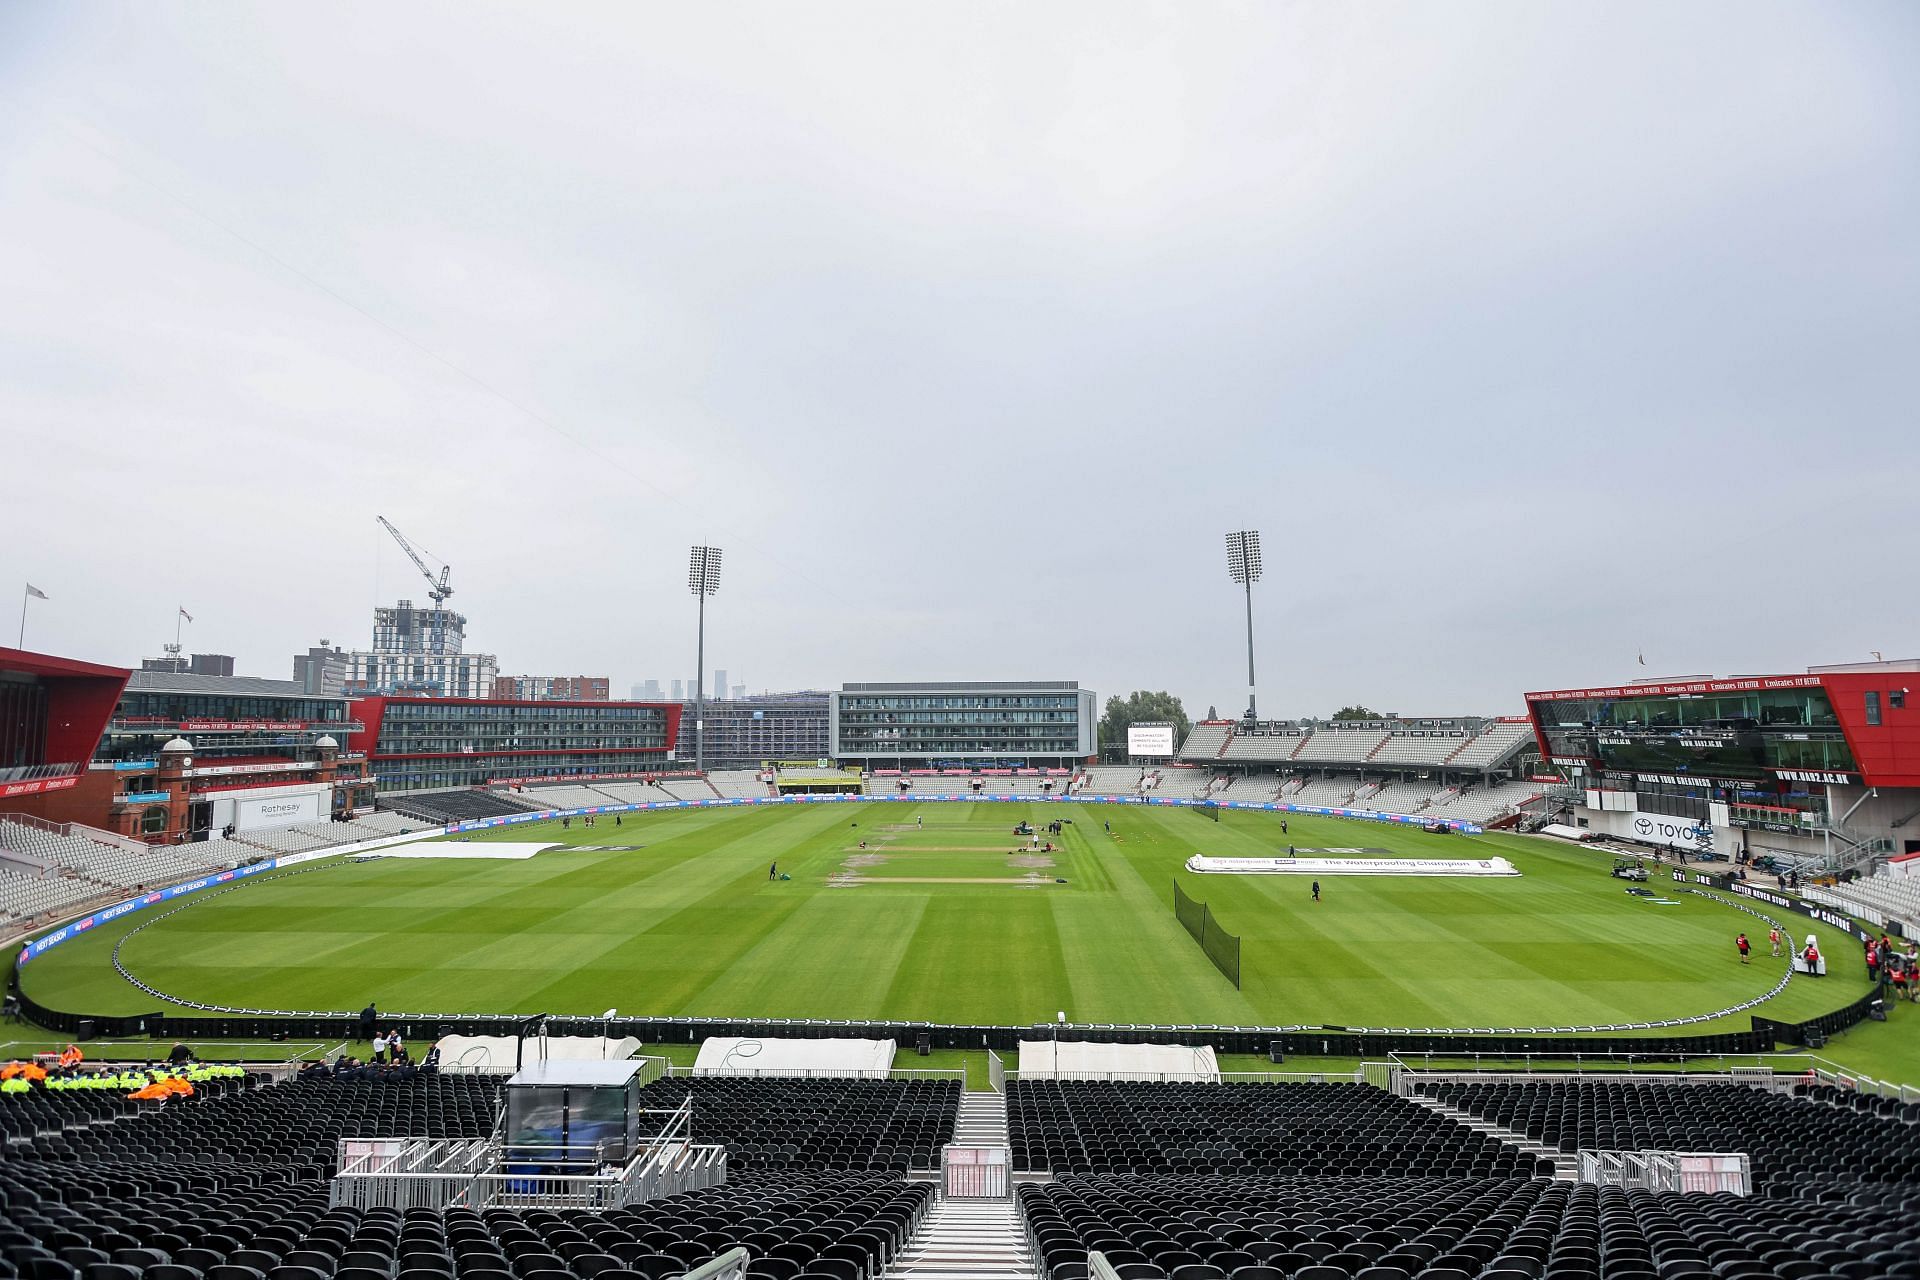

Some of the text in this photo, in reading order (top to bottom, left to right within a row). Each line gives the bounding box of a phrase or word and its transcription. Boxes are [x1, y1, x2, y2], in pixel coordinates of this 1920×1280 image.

[1660, 776, 1676, 785] YOUR
[1676, 777, 1711, 788] GREATNESS
[1718, 780, 1741, 789] UA92
[1776, 770, 1849, 784] WWW.UA92.AC.UK
[262, 804, 300, 813] Rothesay
[1657, 824, 1693, 840] TOYO
[255, 863, 271, 871] SEASON
[172, 880, 207, 895] NEXT SEASON
[1731, 883, 1790, 907] BETTER NEVER STOPS
[103, 902, 134, 920] NEXT SEASON
[1822, 911, 1851, 932] CASTORE
[36, 931, 67, 952] NEXT SEASON
